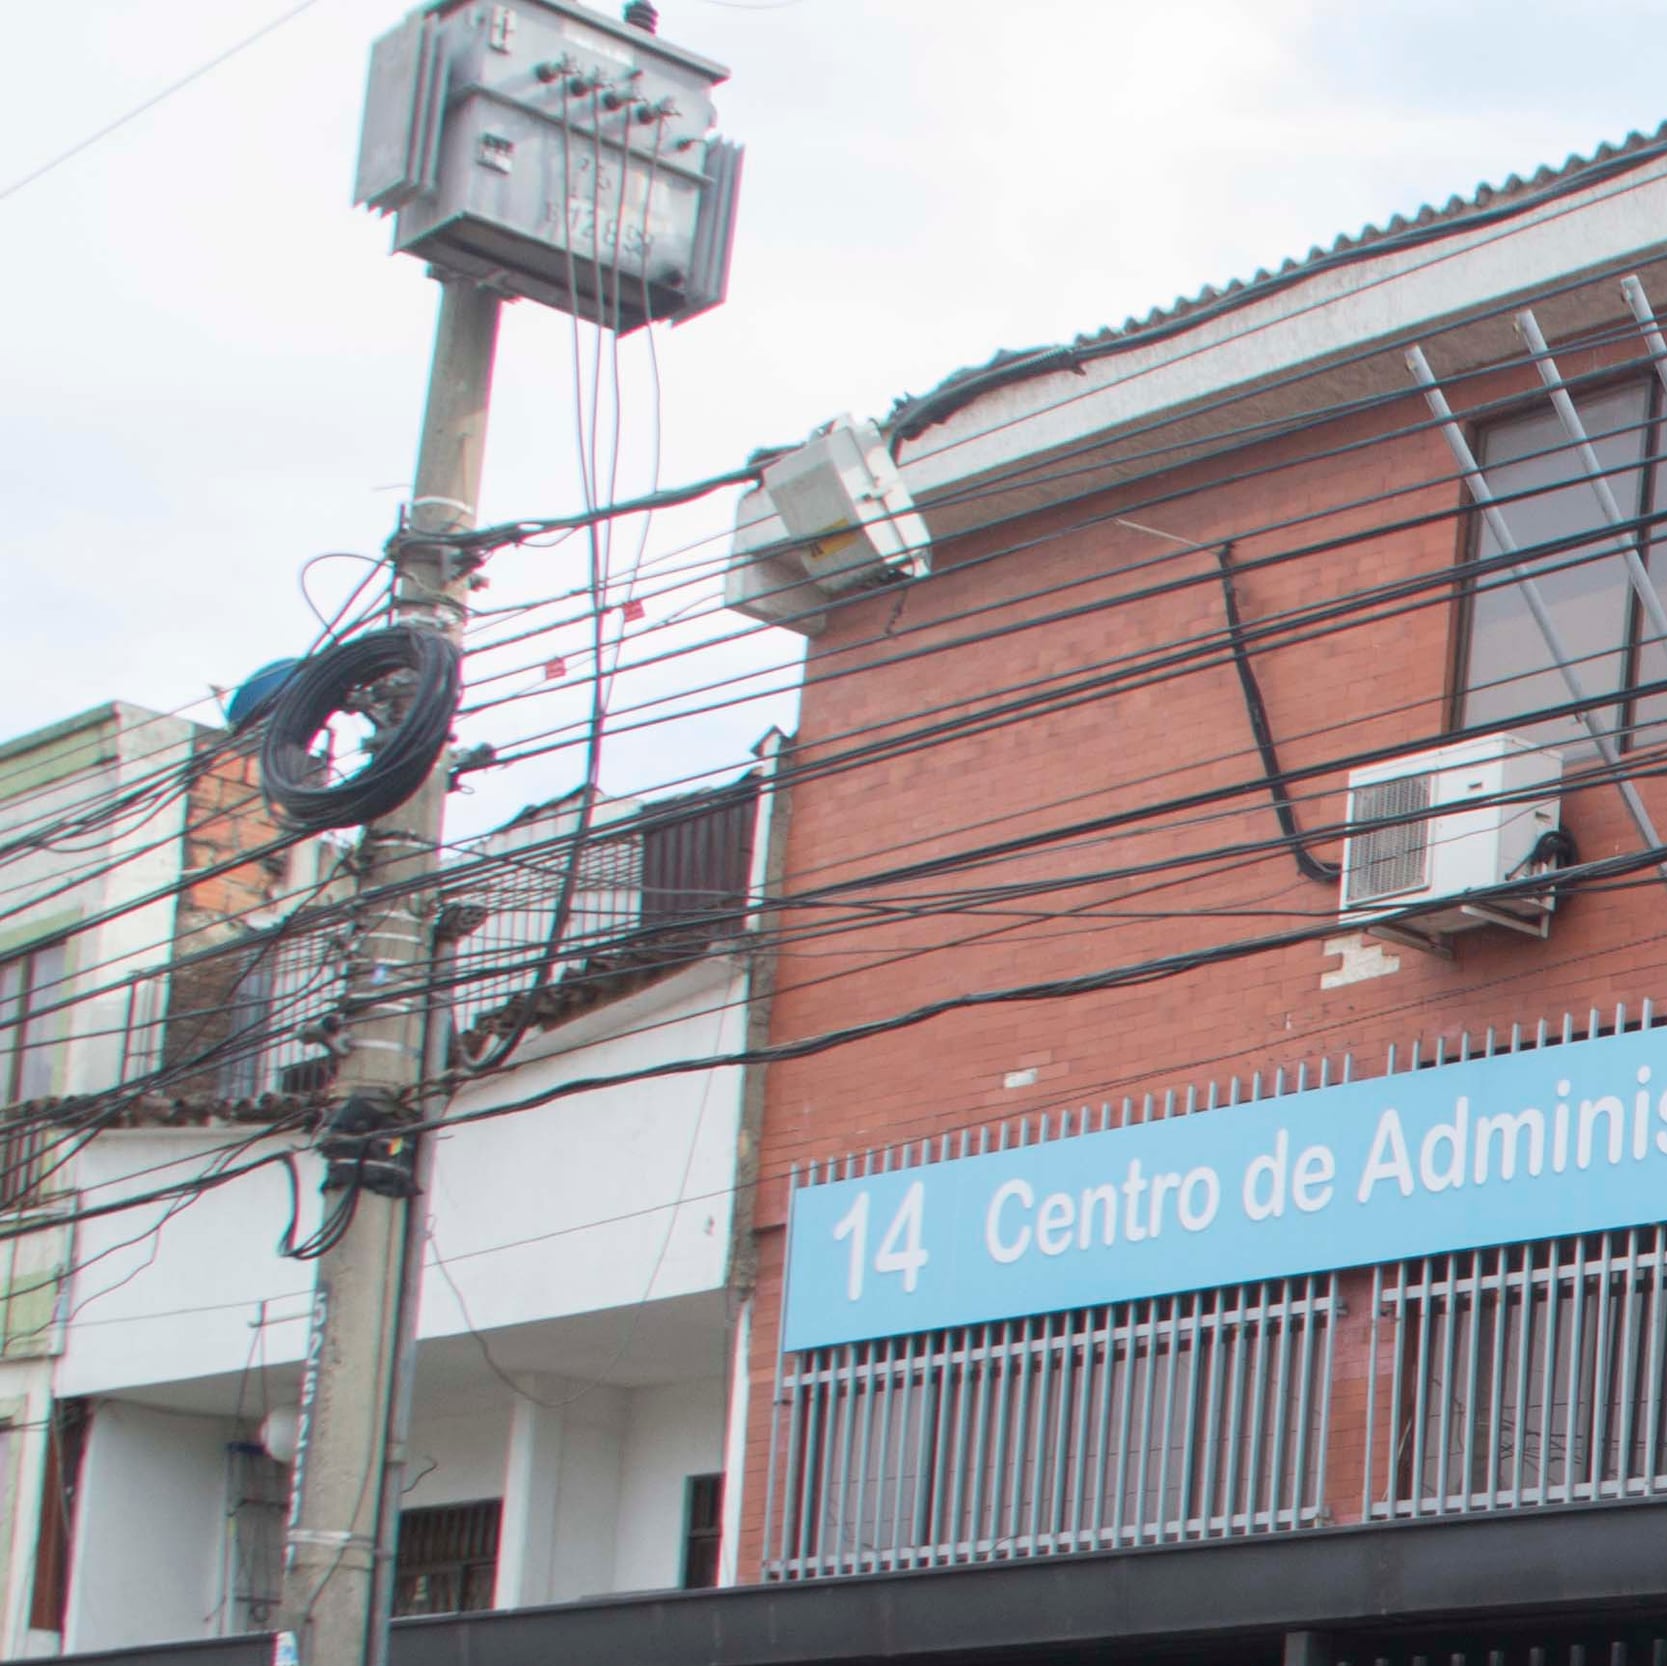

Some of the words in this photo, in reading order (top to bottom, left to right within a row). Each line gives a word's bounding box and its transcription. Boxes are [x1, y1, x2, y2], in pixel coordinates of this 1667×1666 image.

[832, 1180, 928, 1301] 14
[984, 1157, 1220, 1264] Centro
[1242, 1128, 1336, 1221] de
